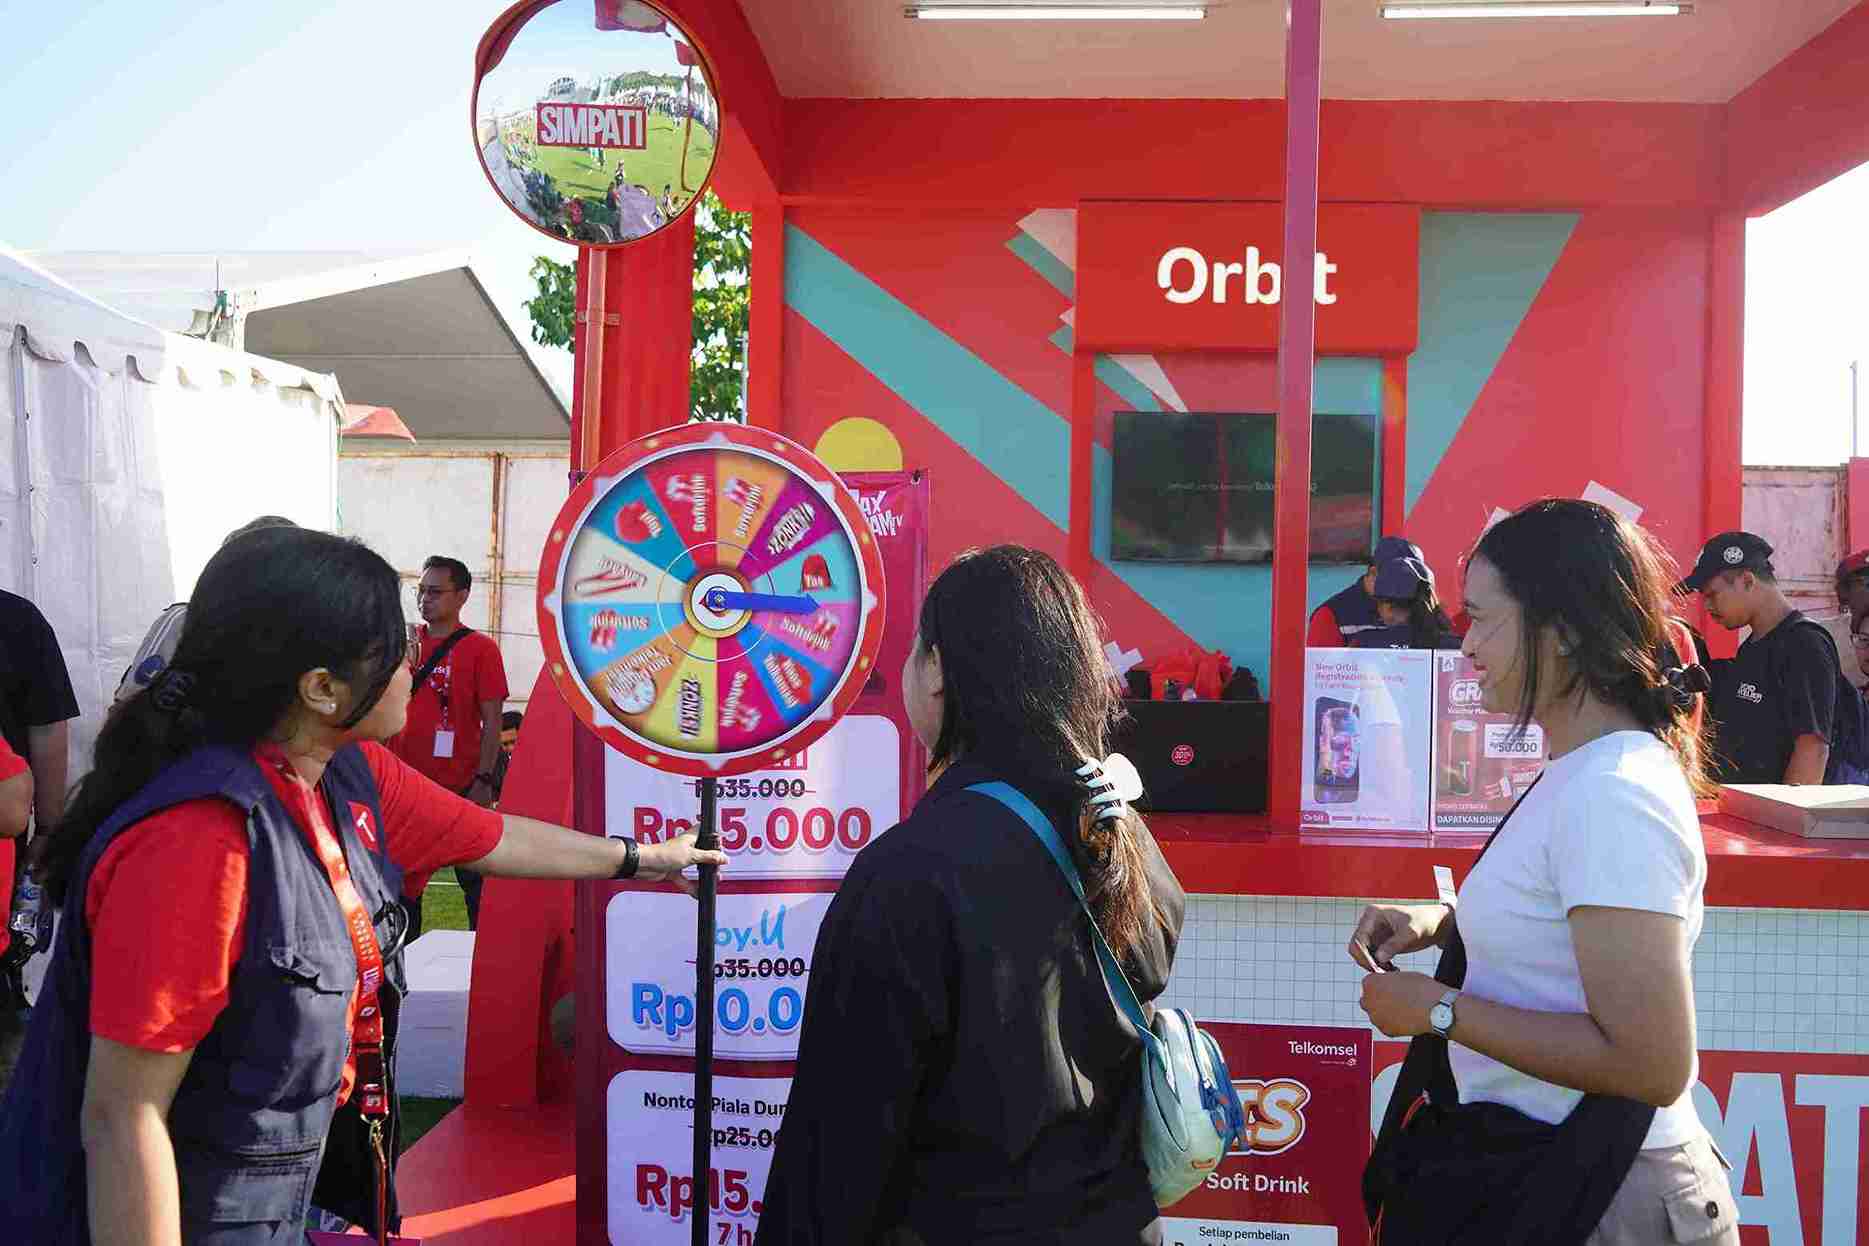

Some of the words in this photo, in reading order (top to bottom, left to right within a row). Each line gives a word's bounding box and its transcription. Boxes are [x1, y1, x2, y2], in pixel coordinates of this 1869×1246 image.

[540, 106, 643, 147] SIMPATI
[1157, 246, 1337, 305] Orbt
[711, 957, 806, 982] p35.000
[632, 982, 802, 1036] Rp0.0
[1287, 1040, 1358, 1057] Telkomsel
[643, 1092, 697, 1110] Nonto
[711, 1096, 750, 1114] Piala
[754, 1099, 790, 1116] Dun
[706, 1126, 781, 1148] p25.0
[636, 1163, 767, 1218] Rp15.
[1206, 1172, 1249, 1191] Soft
[1255, 1174, 1310, 1194] Drink
[717, 1222, 732, 1246] 7
[1199, 1226, 1232, 1240] Setiap
[1233, 1229, 1291, 1242] pembelian
